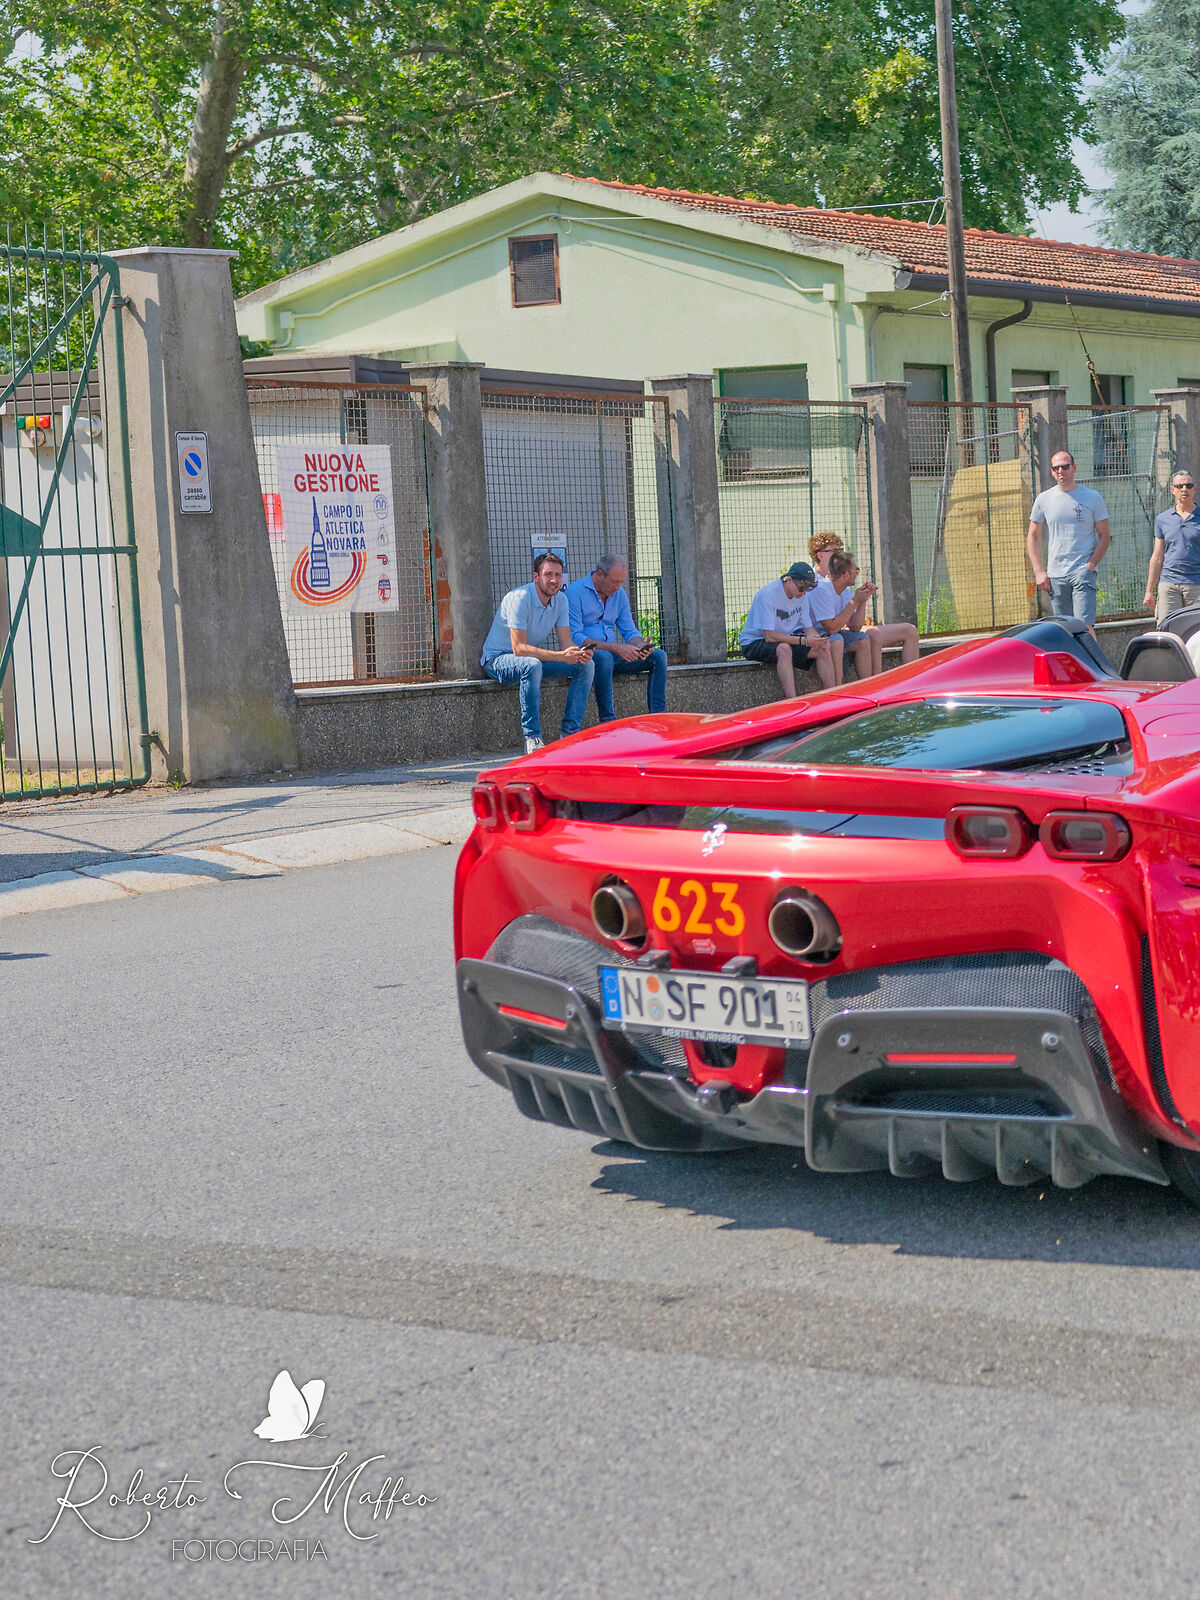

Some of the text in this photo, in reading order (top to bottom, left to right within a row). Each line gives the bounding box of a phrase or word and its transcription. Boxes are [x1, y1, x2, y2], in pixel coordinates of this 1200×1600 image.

[304, 453, 366, 472] NUOVA
[293, 474, 380, 493] GESTIONE
[184, 493, 207, 501] carrabile
[323, 505, 353, 518] CAMPO
[355, 504, 364, 518] DI
[325, 521, 365, 535] ATLETICA
[326, 537, 366, 551] NOVARA
[652, 877, 746, 937] 623
[622, 976, 784, 1031] N SF 901
[790, 1020, 803, 1032] 10
